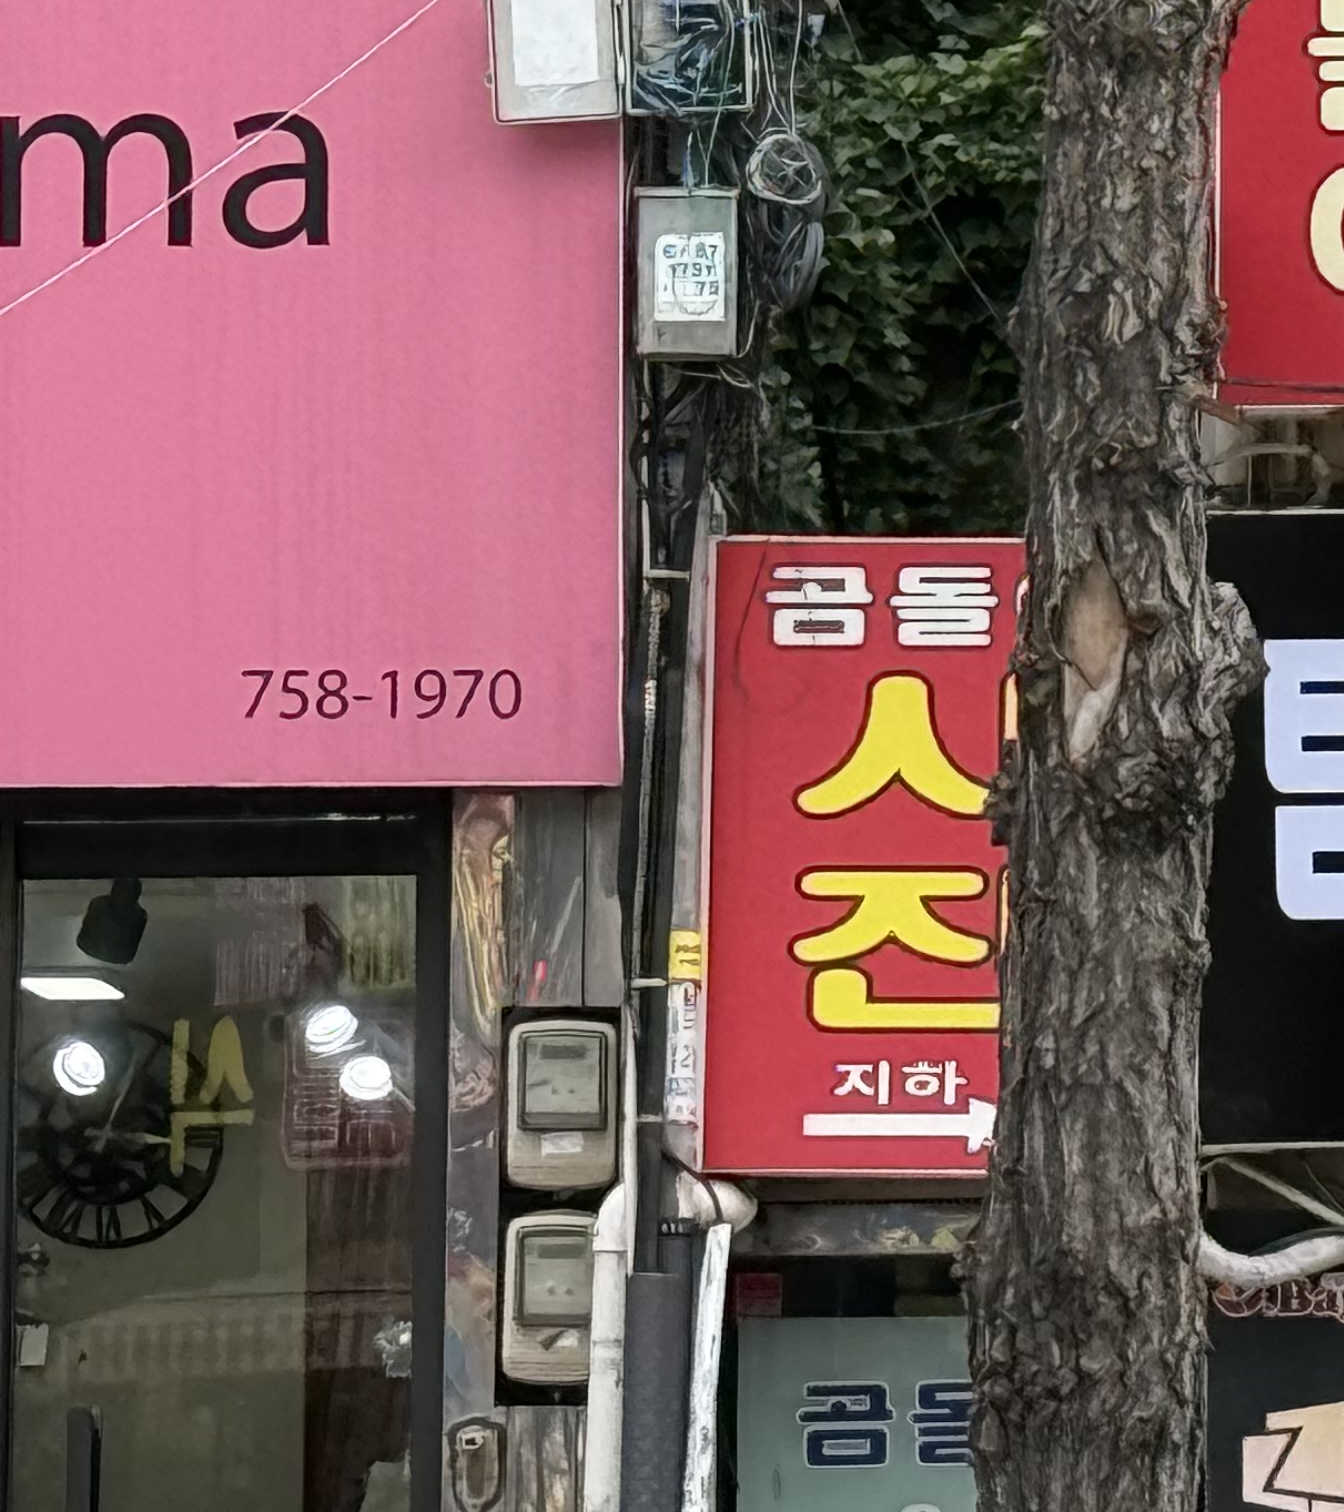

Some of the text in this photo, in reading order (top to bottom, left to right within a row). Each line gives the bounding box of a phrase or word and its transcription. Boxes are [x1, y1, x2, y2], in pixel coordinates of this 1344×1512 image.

[0, 111, 330, 249] ma
[766, 565, 1030, 648] 곰돌
[240, 668, 523, 720] 758-1970
[833, 1060, 968, 1105] 지하
